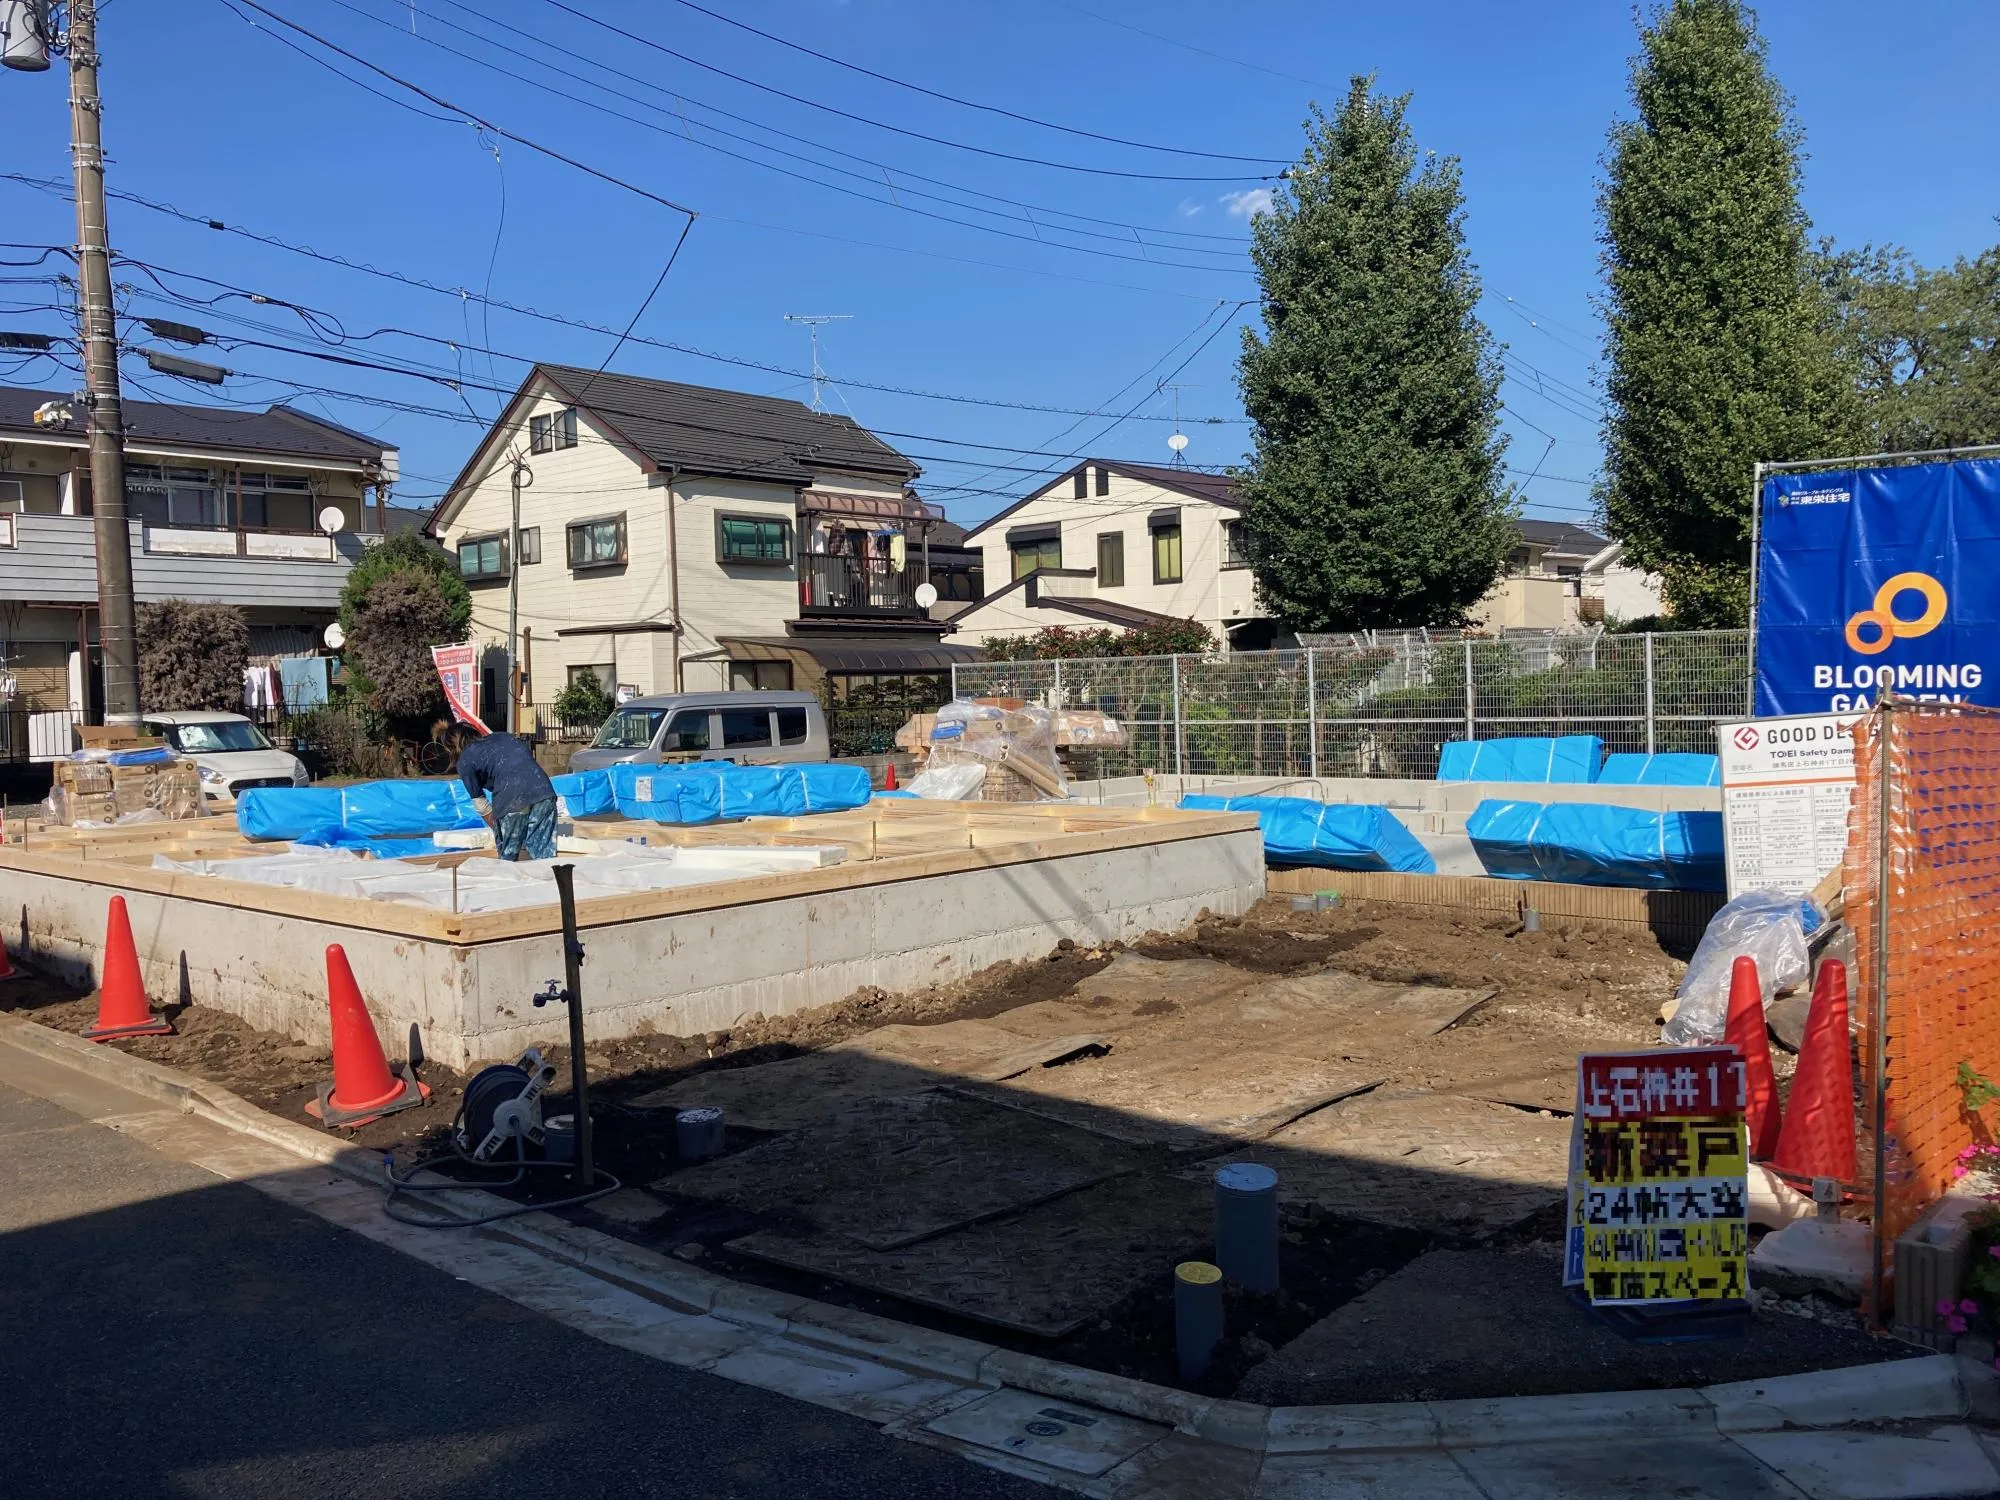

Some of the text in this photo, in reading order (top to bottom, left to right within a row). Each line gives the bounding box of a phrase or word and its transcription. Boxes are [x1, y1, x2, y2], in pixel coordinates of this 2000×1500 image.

[1800, 493, 1850, 504] 東栄住宅
[1814, 664, 1982, 689] BLOOMING
[1831, 693, 1961, 717] GAEN
[1767, 727, 1816, 744] GOOD
[1800, 749, 1828, 757] Safety
